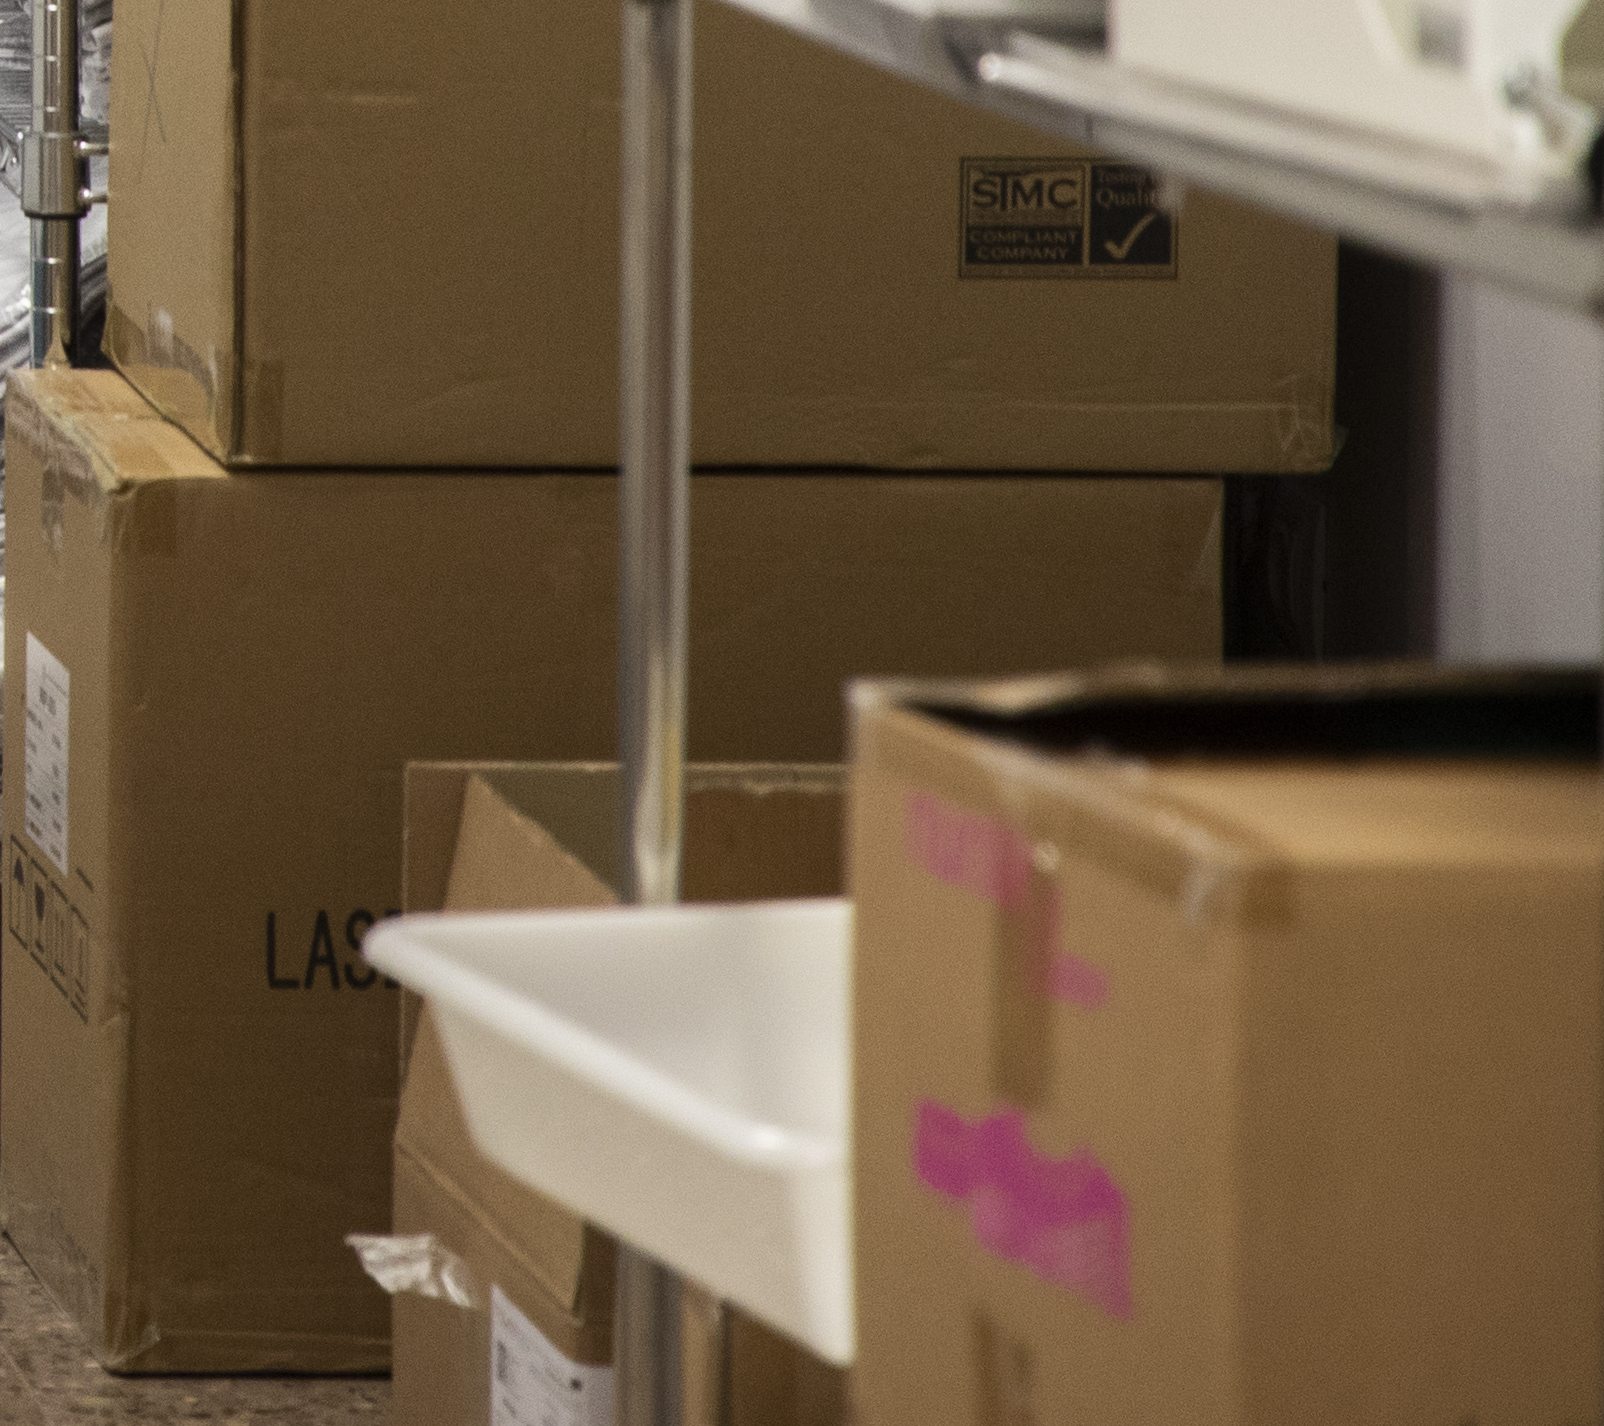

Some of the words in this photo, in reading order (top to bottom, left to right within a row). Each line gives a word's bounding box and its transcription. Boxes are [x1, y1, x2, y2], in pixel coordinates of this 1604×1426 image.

[971, 170, 1078, 211] STMC
[969, 230, 1078, 244] COMPLIANT
[976, 247, 1069, 261] COMPANY
[266, 909, 402, 990] LAS
